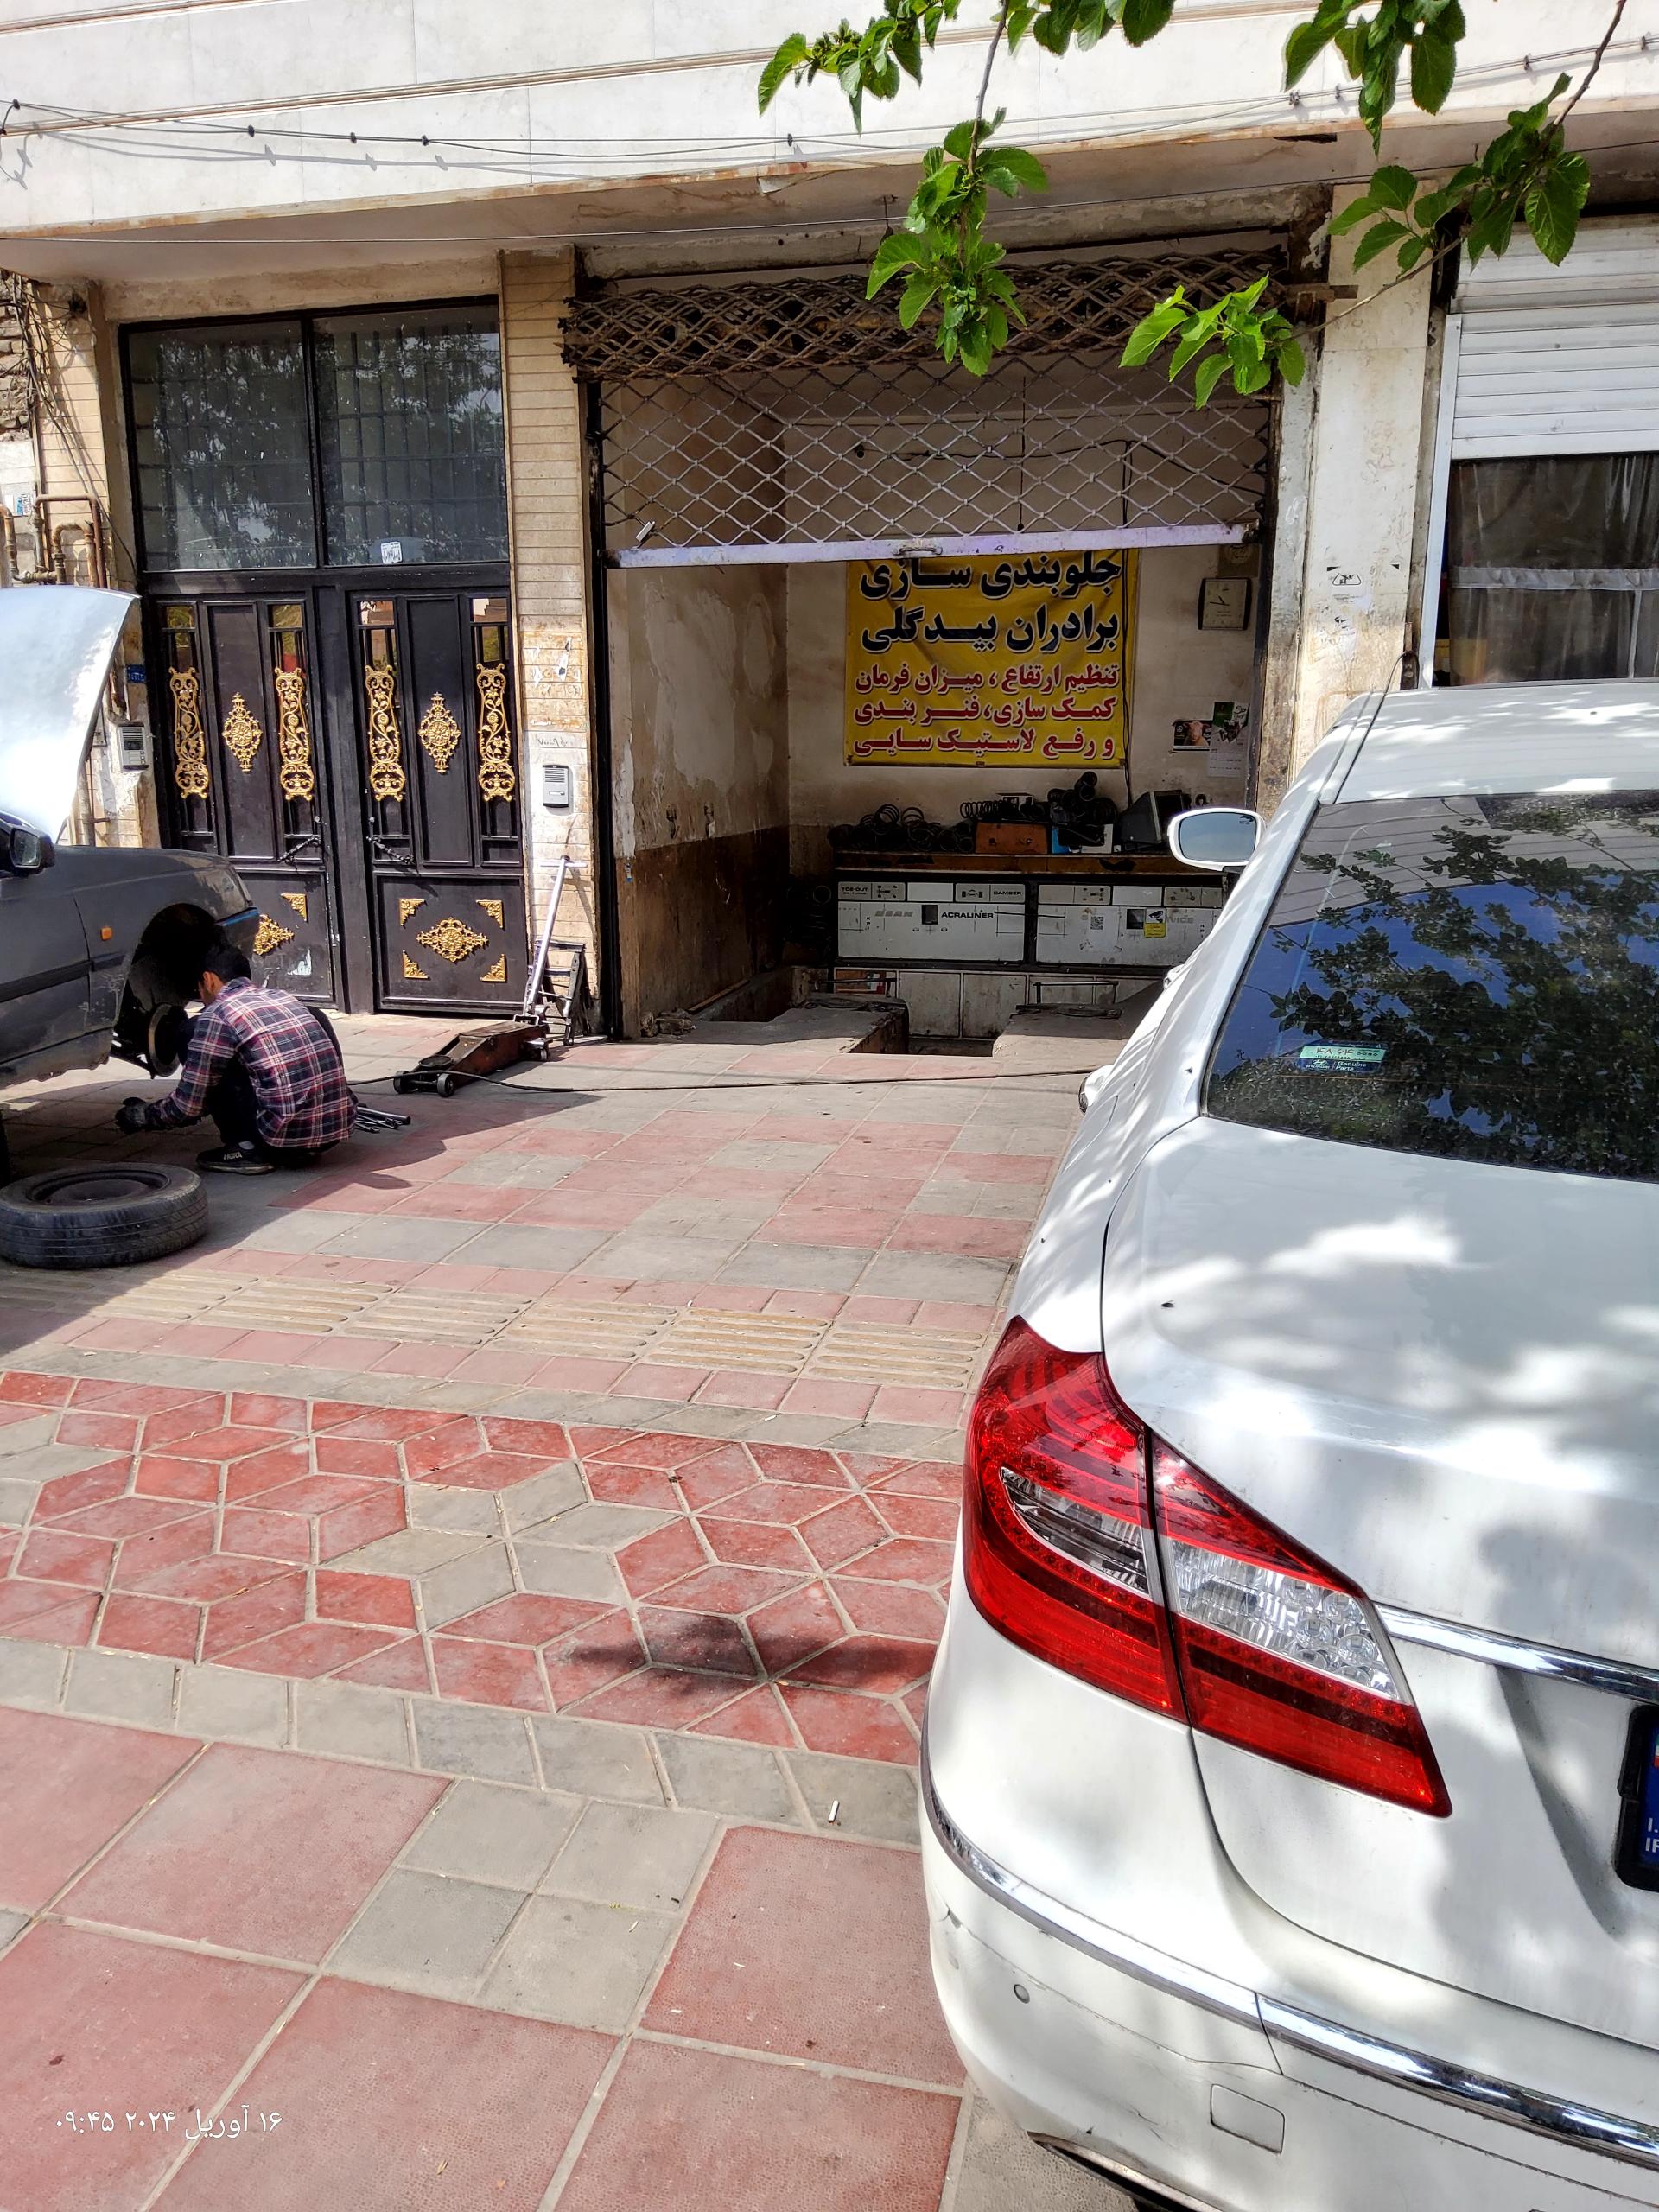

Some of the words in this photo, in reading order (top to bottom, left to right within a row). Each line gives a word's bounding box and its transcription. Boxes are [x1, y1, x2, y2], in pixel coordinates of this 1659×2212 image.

[861, 557, 972, 600] سازی
[980, 550, 1122, 599] جلوبندی
[861, 605, 998, 653] بیدگلی
[1006, 604, 1120, 653] برادران
[855, 663, 910, 693] فرمان
[914, 664, 983, 693] میزان
[1065, 664, 1120, 693] تنظیم
[1051, 696, 1116, 721] کمک
[854, 728, 931, 758] سایی
[937, 728, 1036, 758] لاستیک
[1042, 728, 1095, 760] رفع
[1102, 736, 1115, 760] و
